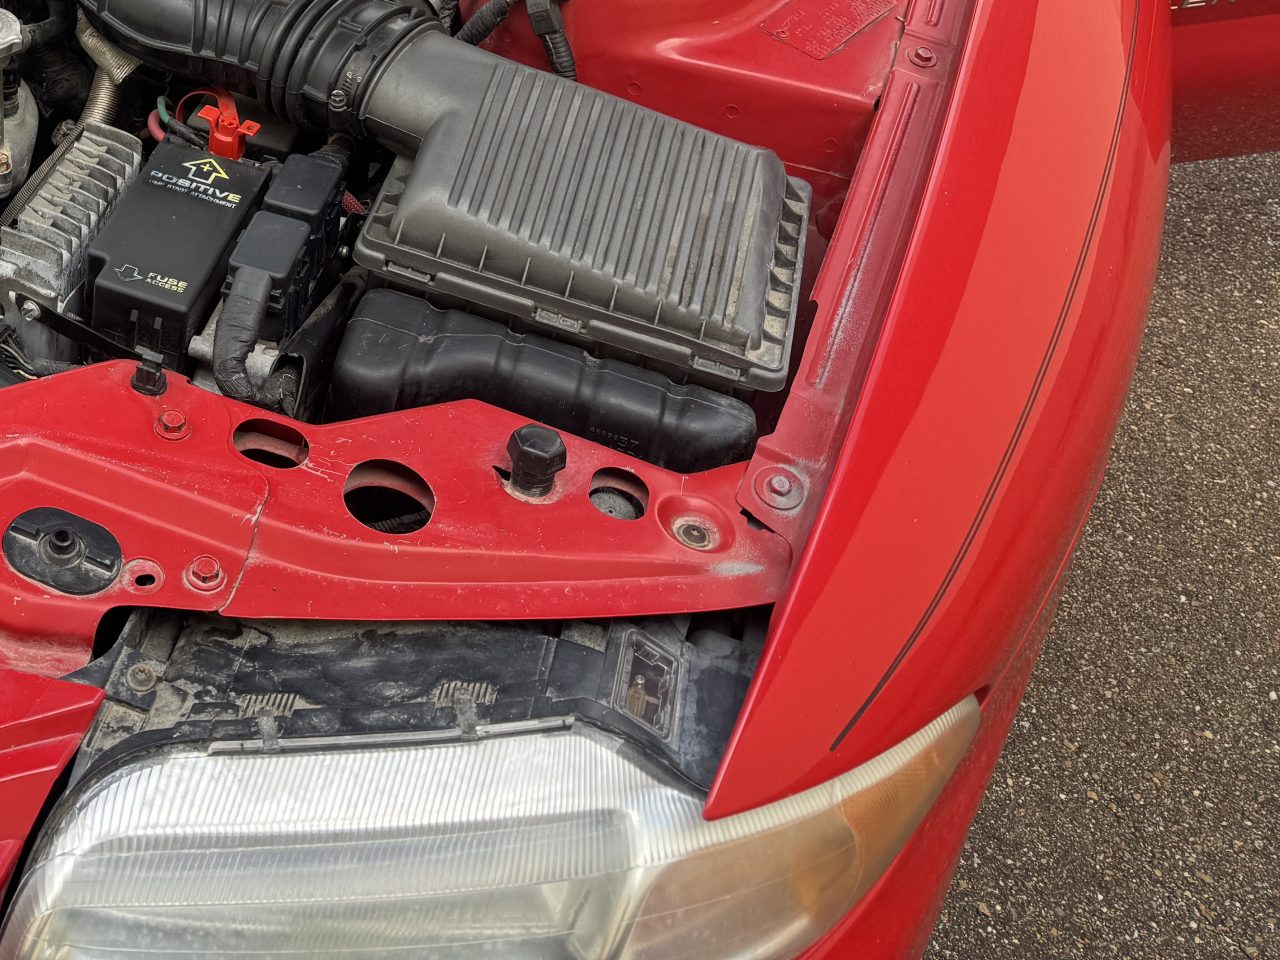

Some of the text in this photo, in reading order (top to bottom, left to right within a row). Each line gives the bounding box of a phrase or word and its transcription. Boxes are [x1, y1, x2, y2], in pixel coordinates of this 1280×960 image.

[150, 170, 241, 203] POSITIVE
[145, 278, 185, 293] ACCESS
[147, 272, 189, 289] FUSE
